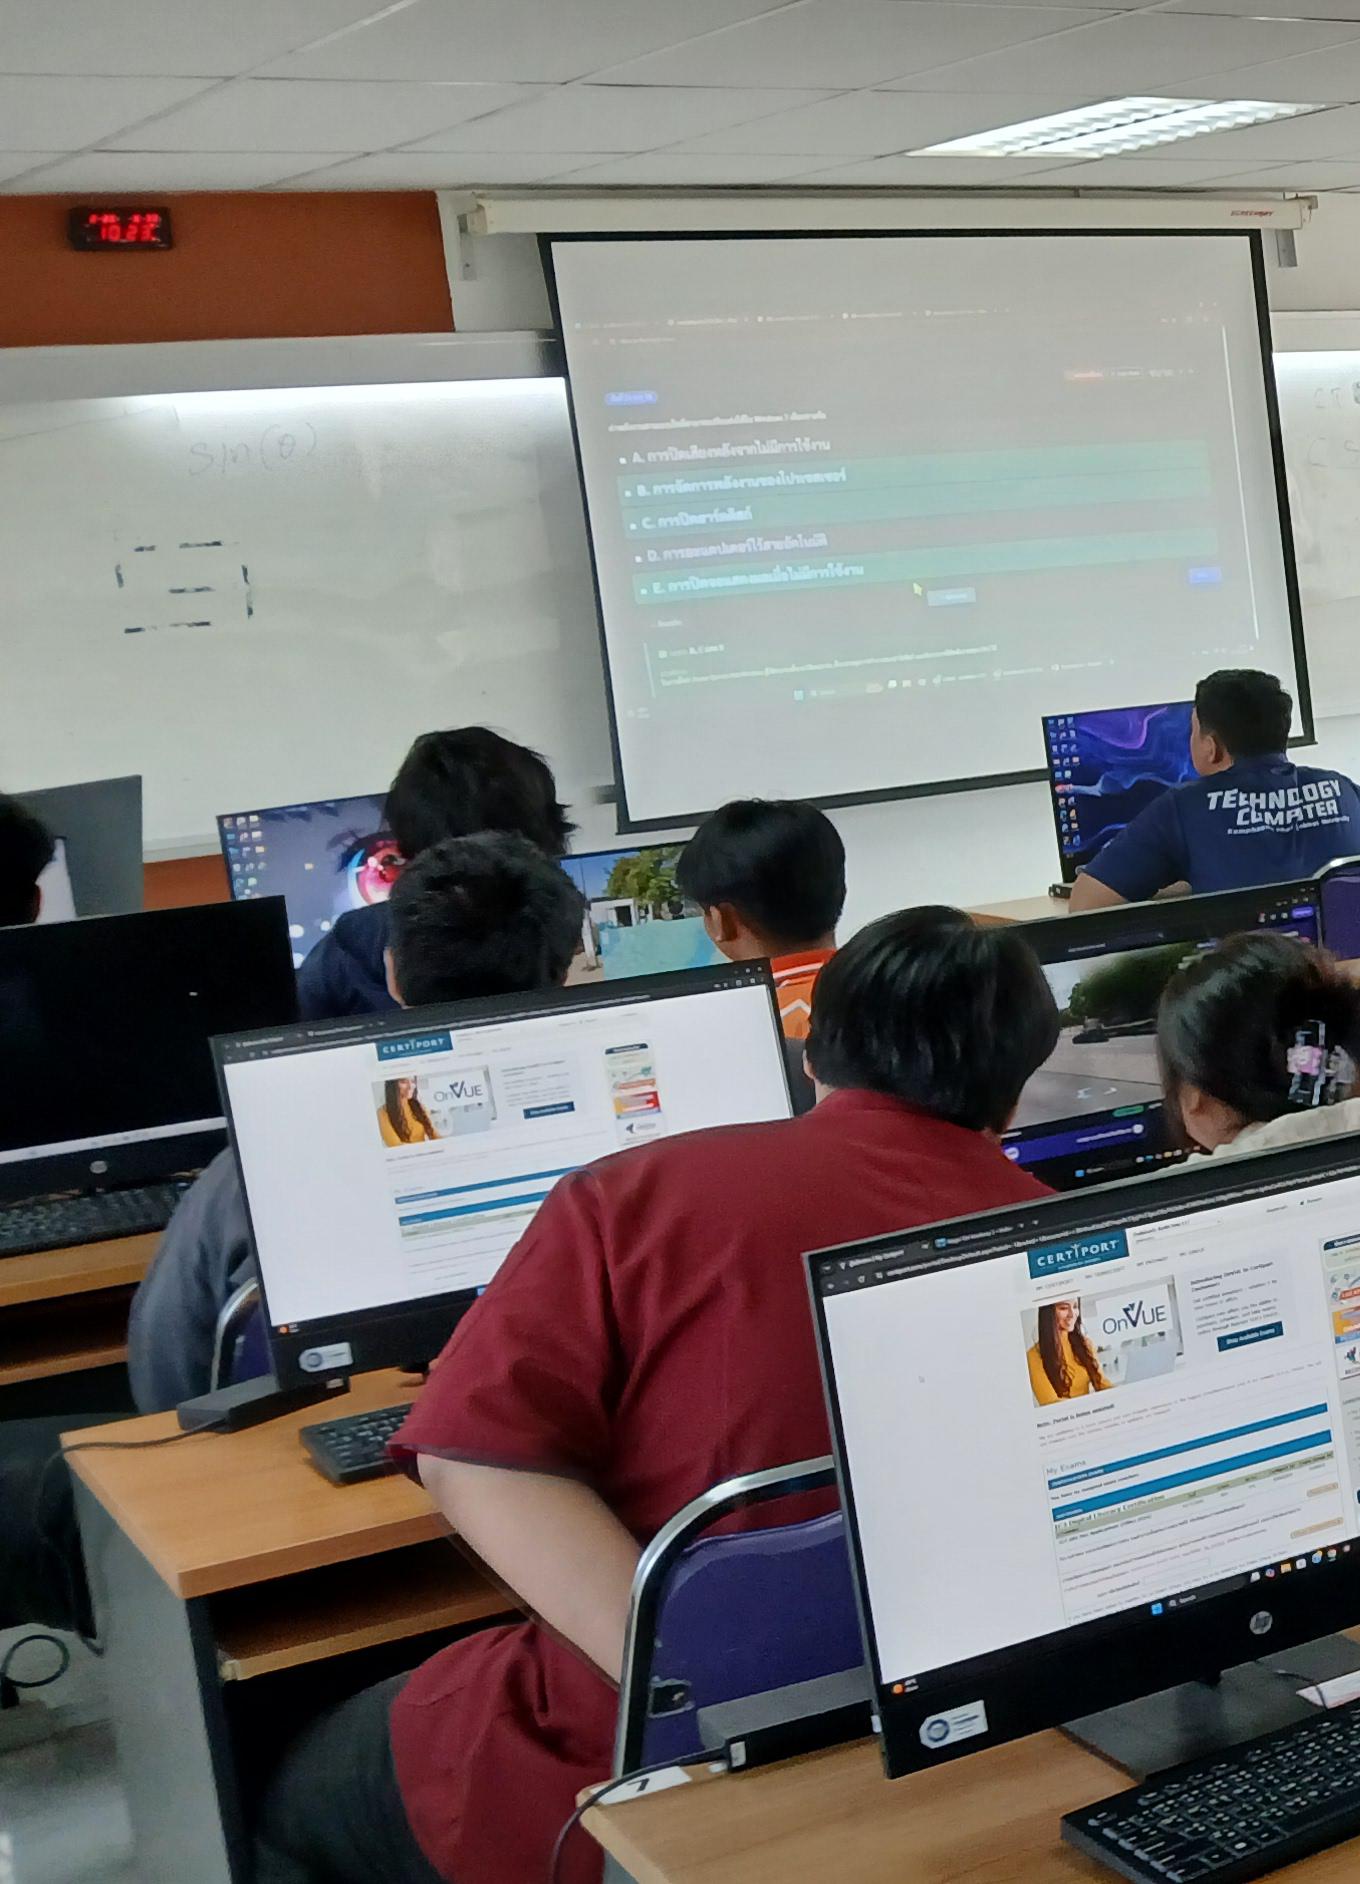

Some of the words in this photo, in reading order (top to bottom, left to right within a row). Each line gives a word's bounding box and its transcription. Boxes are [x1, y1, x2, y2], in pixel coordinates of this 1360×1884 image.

[383, 1038, 446, 1054] CERTIPORT
[434, 1081, 483, 1102] OnVUE
[1037, 1239, 1120, 1267] CERTIPORT
[1103, 1300, 1167, 1335] OnVUE
